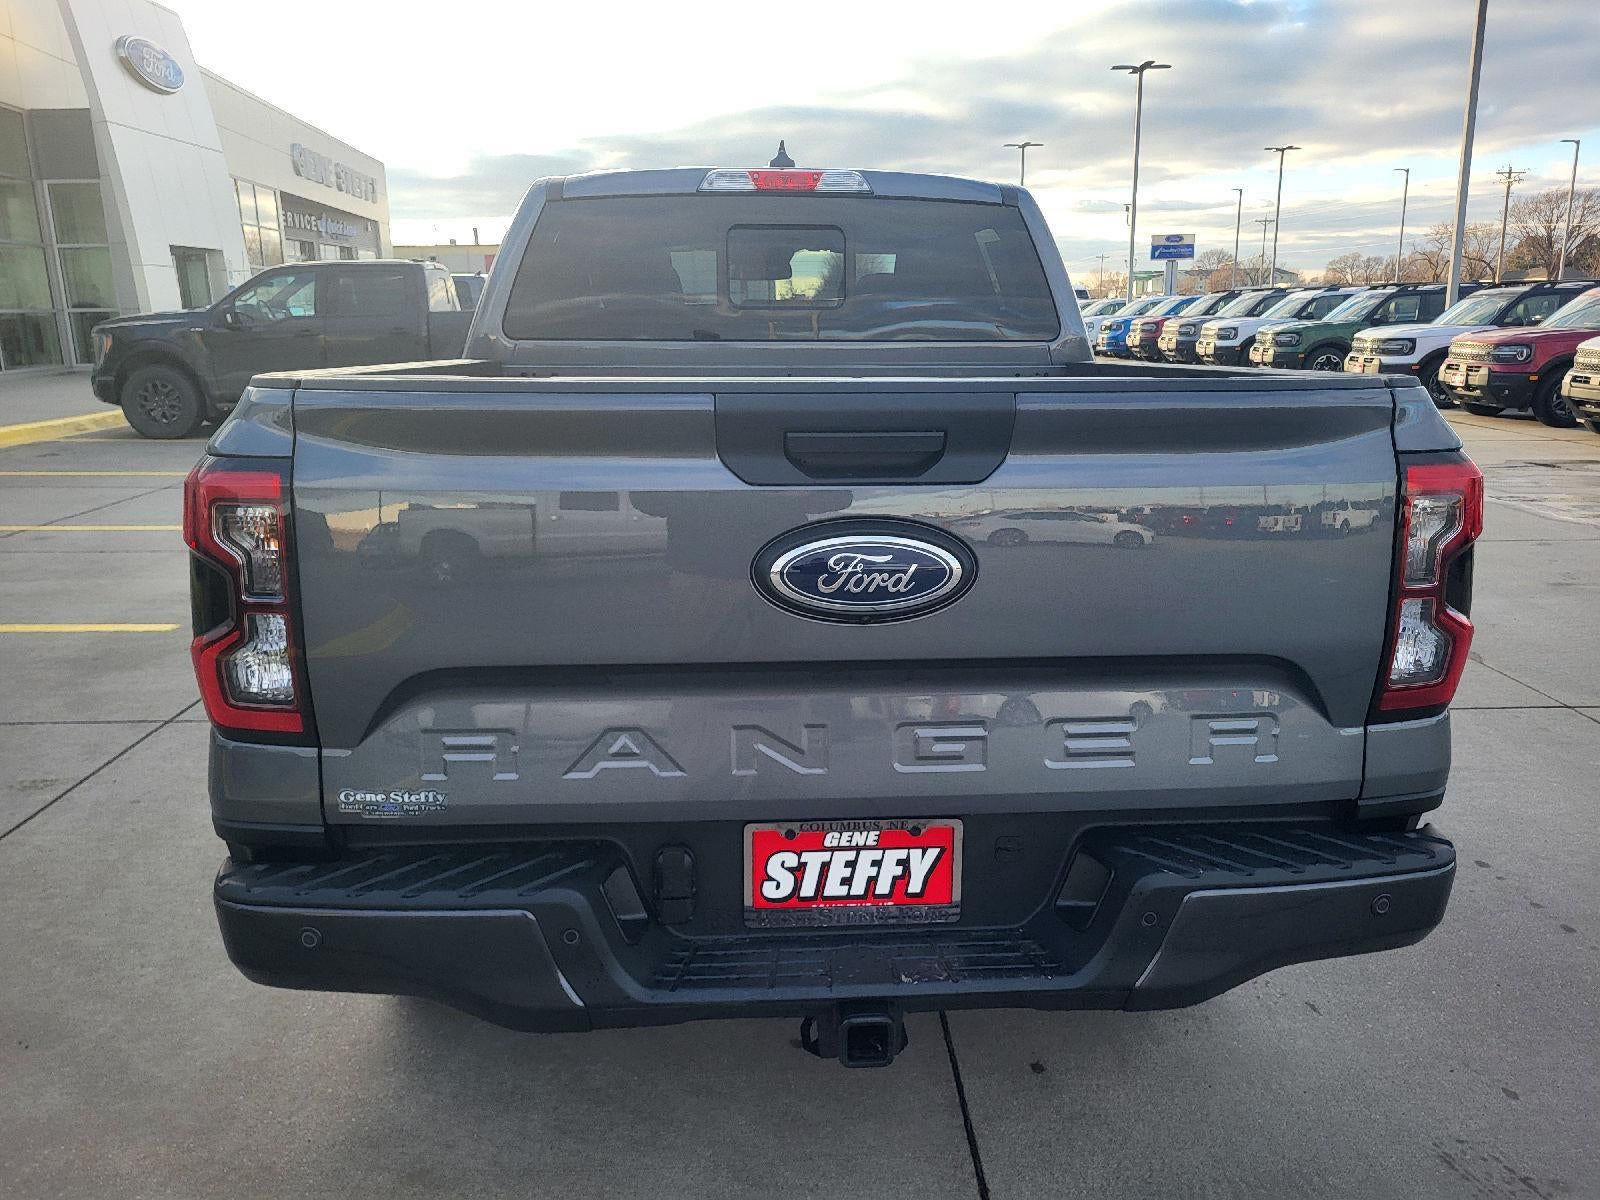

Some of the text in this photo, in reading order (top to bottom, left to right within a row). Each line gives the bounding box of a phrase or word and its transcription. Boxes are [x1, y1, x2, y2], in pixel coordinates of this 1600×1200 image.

[142, 46, 176, 82] Ford
[817, 552, 919, 594] Ford
[420, 711, 1280, 782] RANGER
[340, 791, 447, 804] Gene Steffy
[823, 831, 880, 848] GENE
[887, 820, 909, 830] NE
[760, 847, 945, 902] STEFFY
